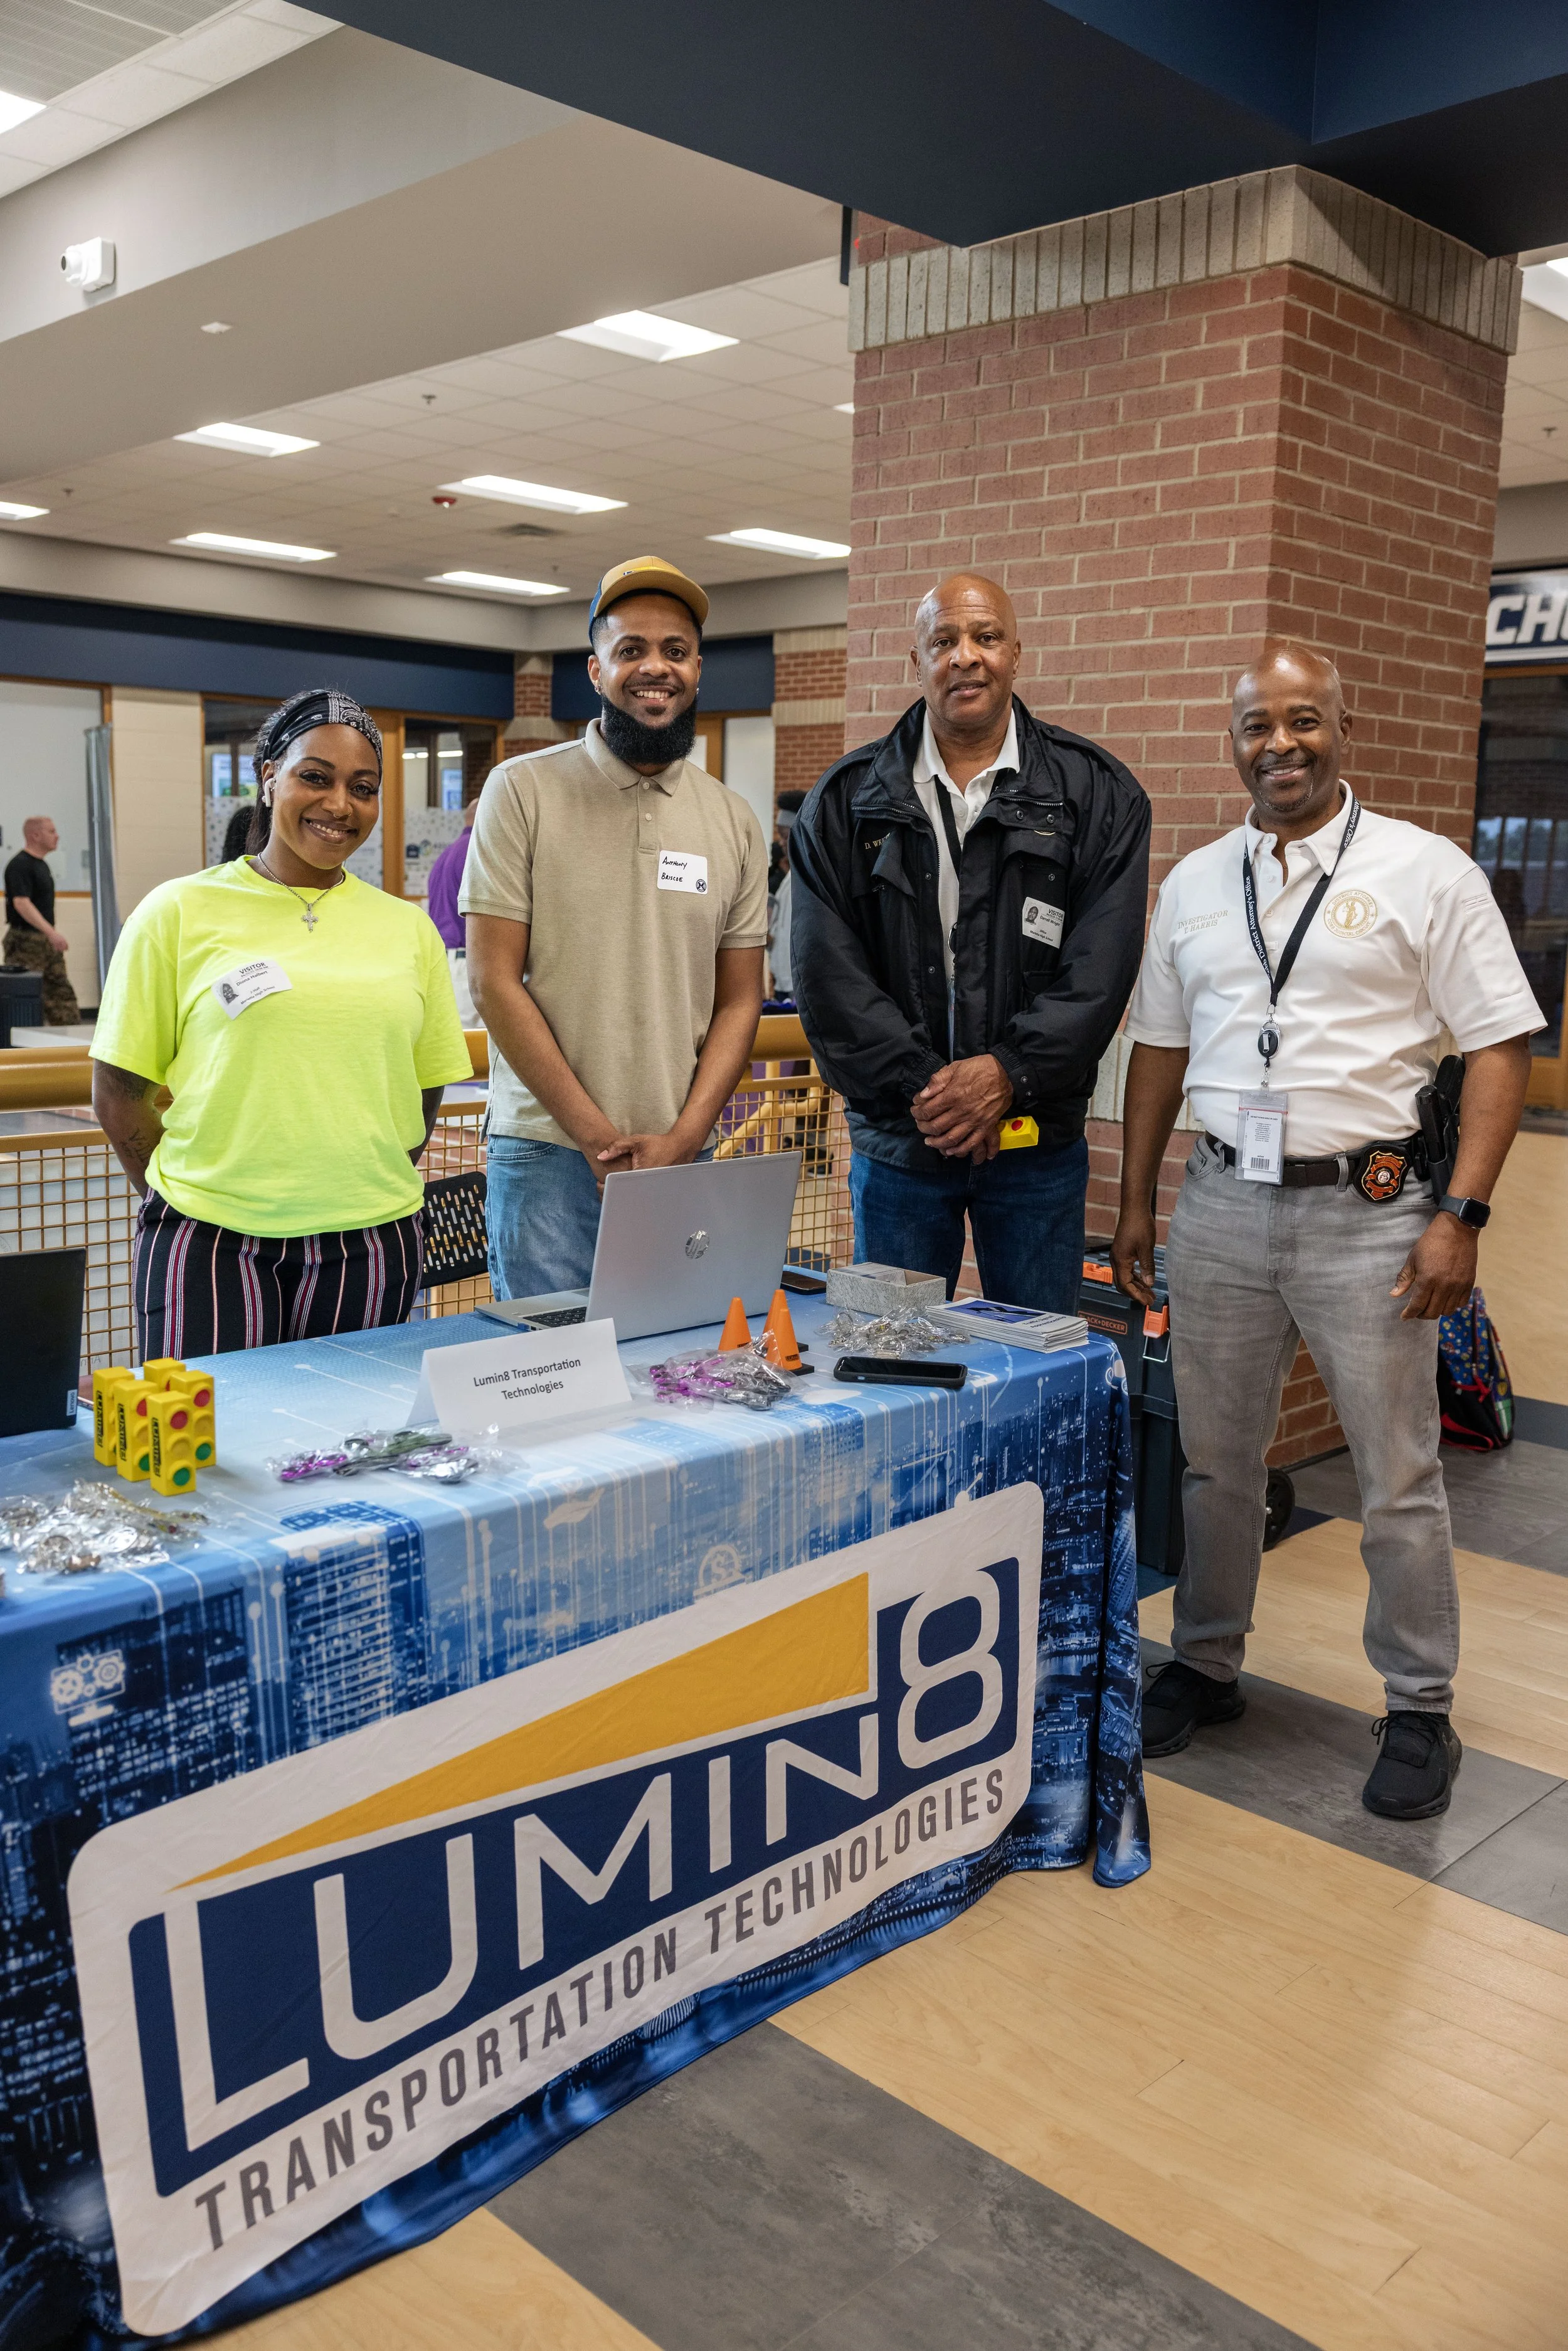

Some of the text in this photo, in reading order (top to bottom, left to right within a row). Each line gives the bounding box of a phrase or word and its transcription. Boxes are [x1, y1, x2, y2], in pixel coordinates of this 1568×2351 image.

[1486, 593, 1568, 645] CH
[1332, 891, 1352, 905] DISTRICT
[1177, 910, 1228, 929] INVESTIGATOR
[1190, 920, 1217, 932] HARRIS
[1252, 930, 1265, 958] District
[239, 962, 266, 974] VISITOR
[236, 970, 268, 986] Diona Halbert
[474, 1359, 581, 1387] Lumin8 Transportation
[501, 1381, 564, 1399] Technologies
[163, 1564, 1002, 2152] LUMIN8
[194, 1768, 1004, 2251] TRANSPORTATION TECHNOLOGIES
